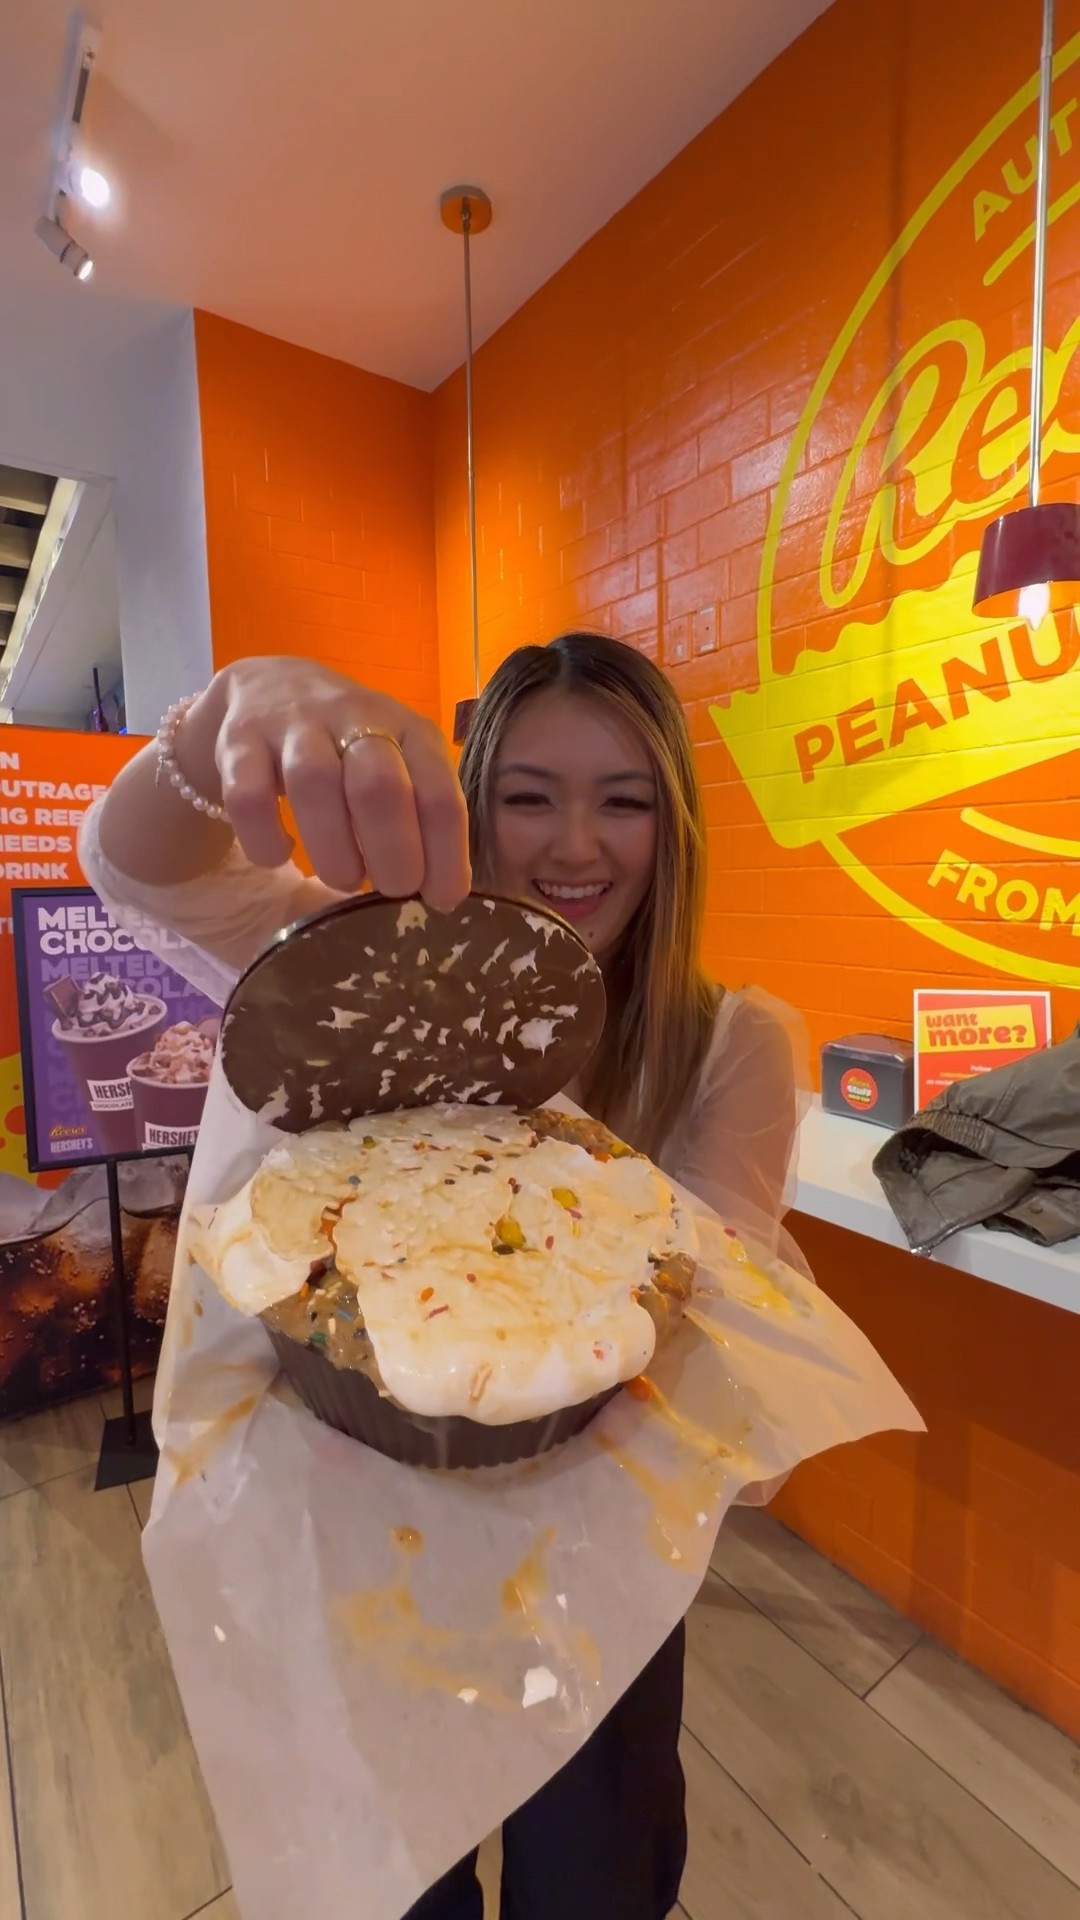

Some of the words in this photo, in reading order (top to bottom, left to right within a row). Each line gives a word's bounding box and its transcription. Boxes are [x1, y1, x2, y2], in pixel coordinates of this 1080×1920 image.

[820, 316, 1080, 608] Re
[793, 609, 1080, 784] PEANU
[0, 779, 110, 801] UTRAGE
[0, 834, 72, 853] EEDS
[927, 849, 1080, 936] FROM
[926, 1013, 978, 1028] want
[928, 1025, 1027, 1047] more?
